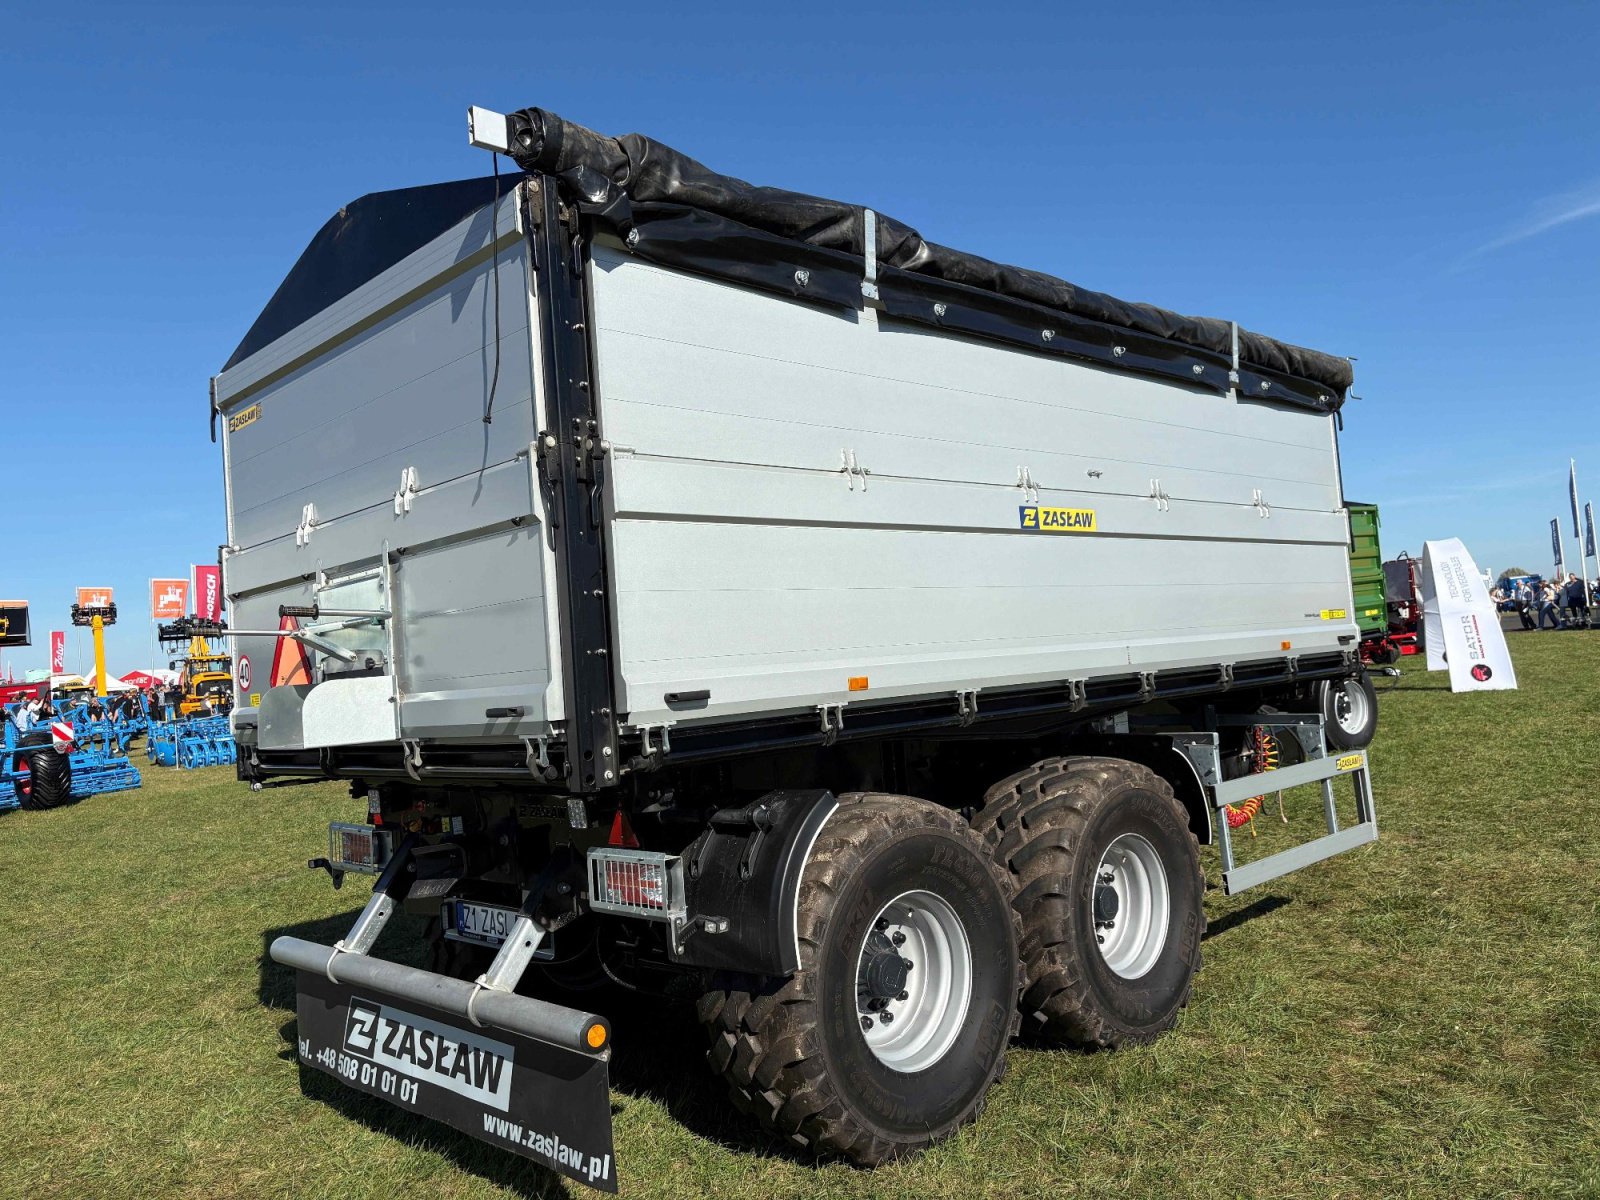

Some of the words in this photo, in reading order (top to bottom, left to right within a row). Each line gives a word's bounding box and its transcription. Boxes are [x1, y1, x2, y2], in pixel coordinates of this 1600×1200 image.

[1043, 510, 1093, 528] ZASŁAW
[1441, 561, 1460, 599] TECHNOLOGY
[1461, 587, 1473, 603] FOR
[1461, 615, 1480, 660] SATOR
[240, 663, 249, 683] 40
[463, 906, 477, 931] Z1
[481, 909, 518, 937] ZASL
[381, 1017, 505, 1095] ZASŁAW
[316, 1047, 337, 1070] +48
[337, 1052, 359, 1081] 508
[361, 1063, 378, 1088] 01
[381, 1070, 397, 1096] 01
[400, 1079, 419, 1105] 01
[483, 1112, 610, 1182] www.zaslaw.pl
